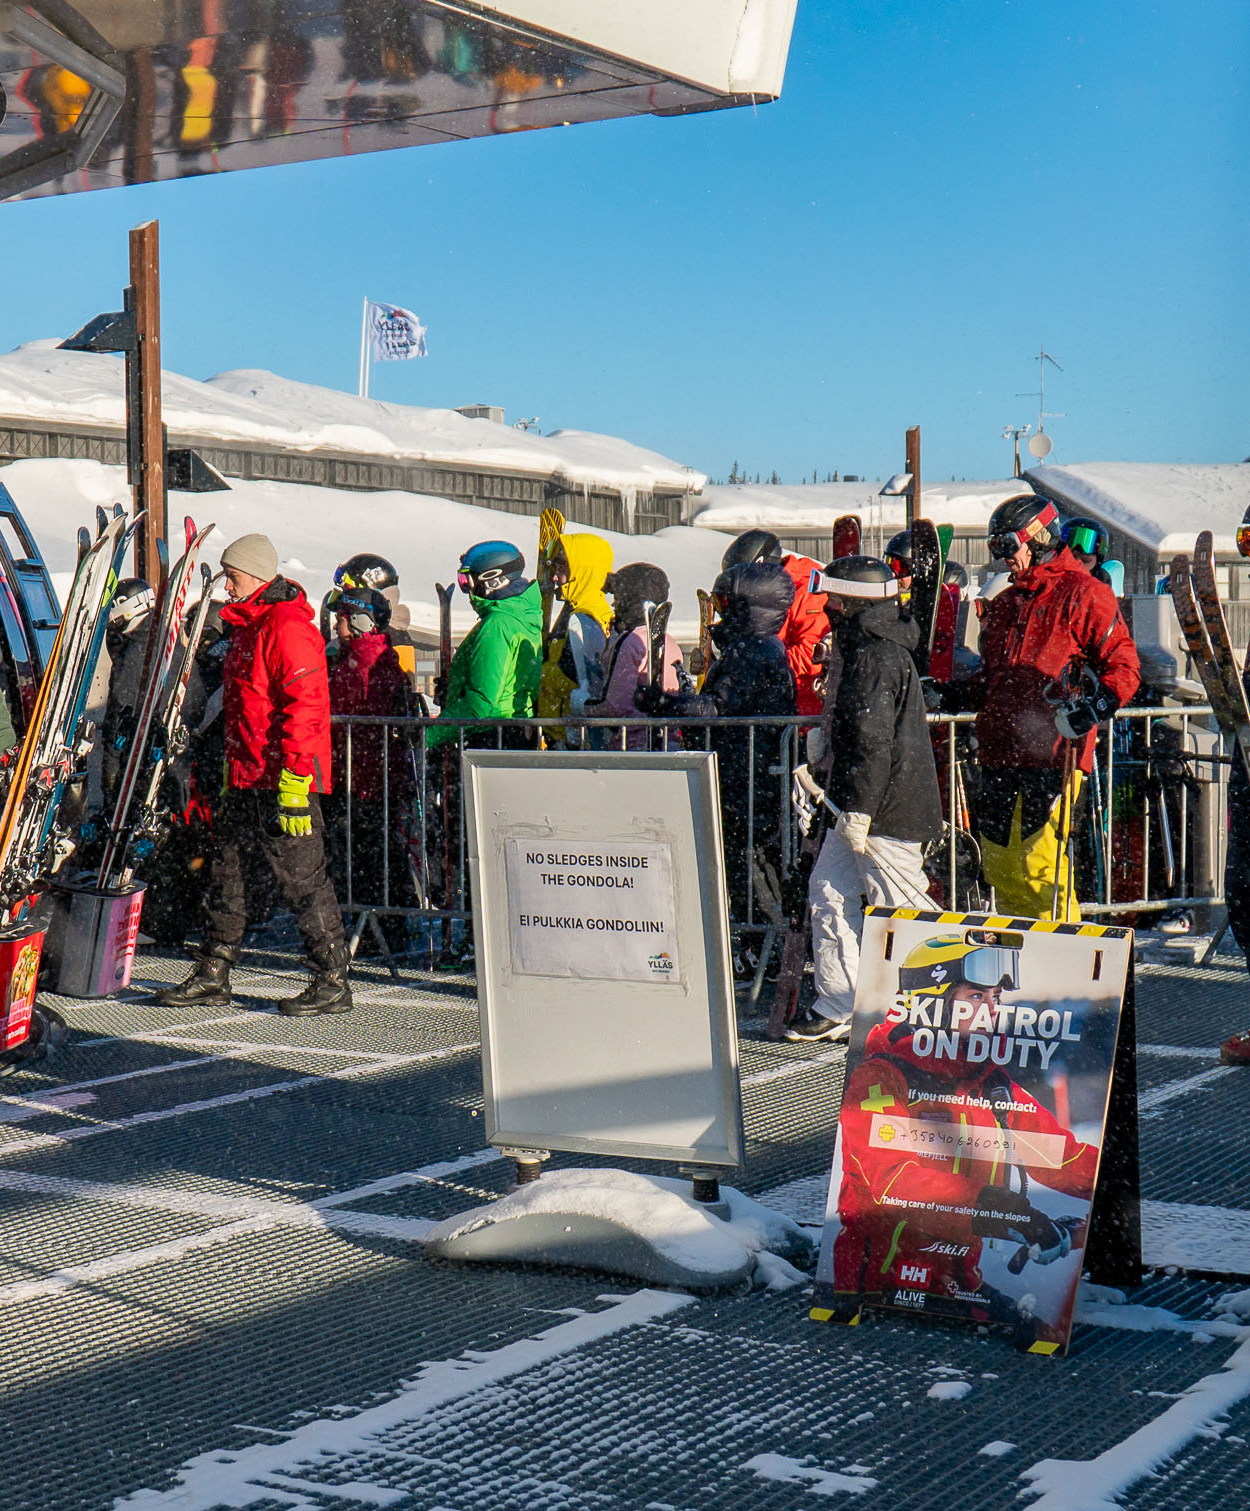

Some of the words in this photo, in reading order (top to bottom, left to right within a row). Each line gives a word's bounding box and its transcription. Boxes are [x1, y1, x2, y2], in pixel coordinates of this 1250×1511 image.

[526, 853, 545, 864] NO
[547, 853, 603, 867] SLEDGES
[606, 856, 649, 868] INSIDE
[541, 873, 565, 885] THE
[567, 874, 634, 888] GONDOLA!
[519, 914, 530, 926] EI
[533, 915, 584, 929] PULKKIA
[586, 918, 664, 933] GONDOLIIN!
[648, 959, 674, 969] YLLÄS
[887, 994, 945, 1028] SKI
[951, 999, 1081, 1042] PATROL
[912, 1028, 960, 1060] ON
[967, 1033, 1060, 1070] DUTY
[908, 1088, 917, 1100] If
[917, 1092, 937, 1104] you
[938, 1094, 965, 1105] need
[966, 1095, 993, 1110] help,
[994, 1100, 1038, 1113] contact:
[882, 1195, 907, 1208] Taking
[908, 1200, 926, 1209] care
[926, 1202, 936, 1210] of
[936, 1203, 953, 1213] your
[954, 1205, 979, 1218] safety
[980, 1209, 990, 1217] on
[991, 1209, 1004, 1219] the
[1005, 1212, 1031, 1223] slopes
[937, 1243, 970, 1257] ski.fi
[901, 1264, 927, 1283] HH
[894, 1289, 926, 1303] ALIVE
